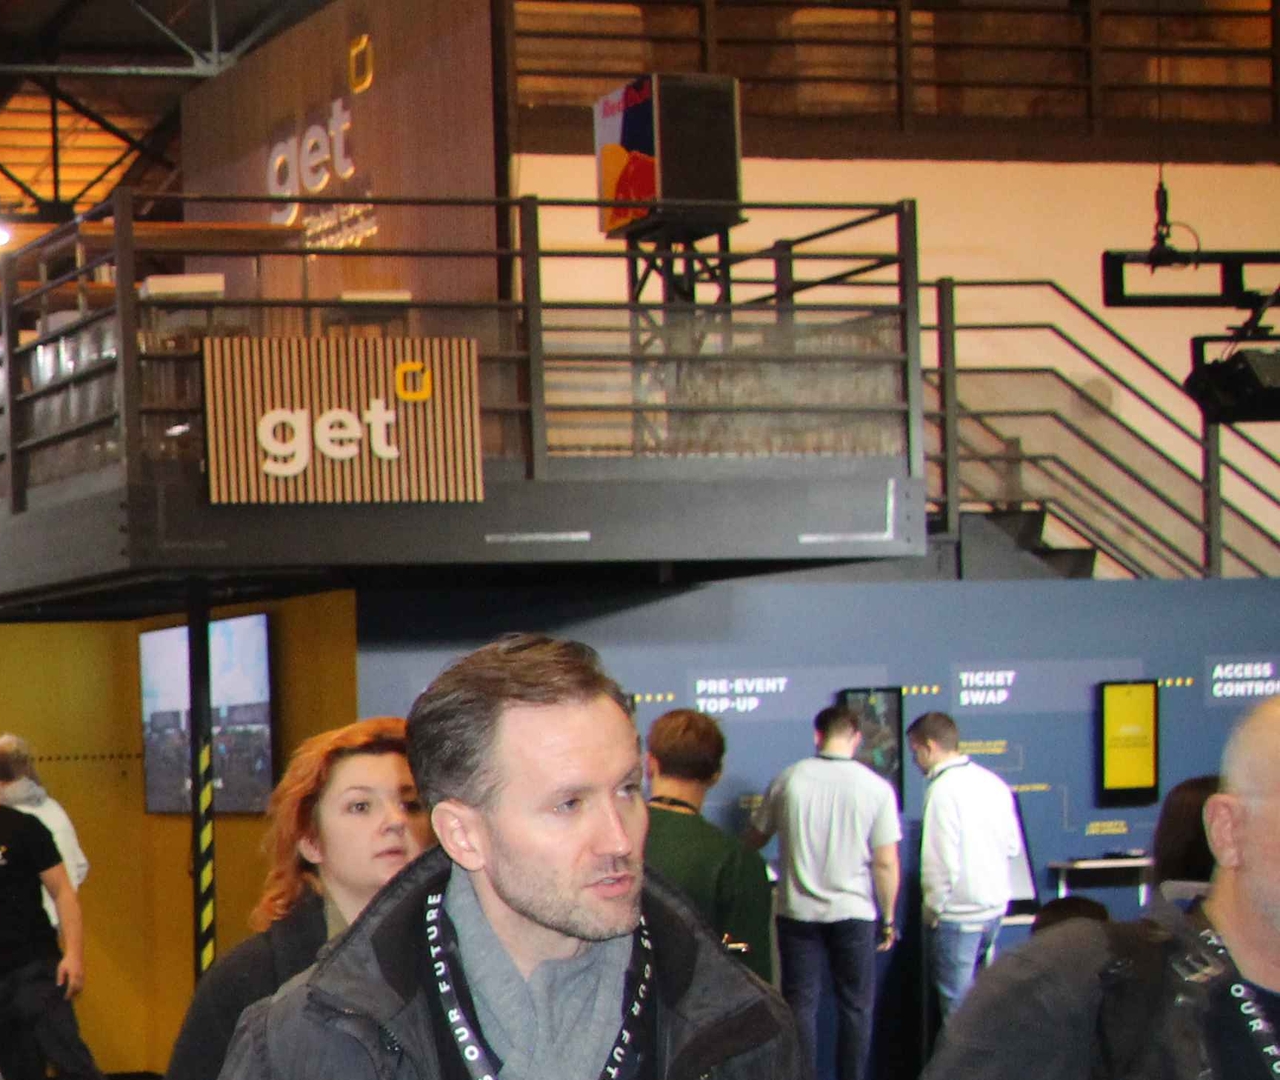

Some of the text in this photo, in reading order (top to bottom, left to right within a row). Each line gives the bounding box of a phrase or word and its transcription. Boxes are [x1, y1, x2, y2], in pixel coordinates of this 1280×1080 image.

[267, 98, 355, 226] get
[257, 398, 400, 478] get
[696, 677, 788, 694] PRE-EVENT
[959, 670, 1016, 687] TICKET
[1212, 662, 1272, 680] ACCESS
[697, 697, 759, 713] TOP-UP
[959, 689, 1009, 705] SWAP
[1212, 679, 1280, 698] CONTRO
[425, 893, 451, 994] FUTURE
[627, 963, 652, 1017] OUR
[1230, 983, 1264, 1032] OUR
[447, 1007, 480, 1062] OUR
